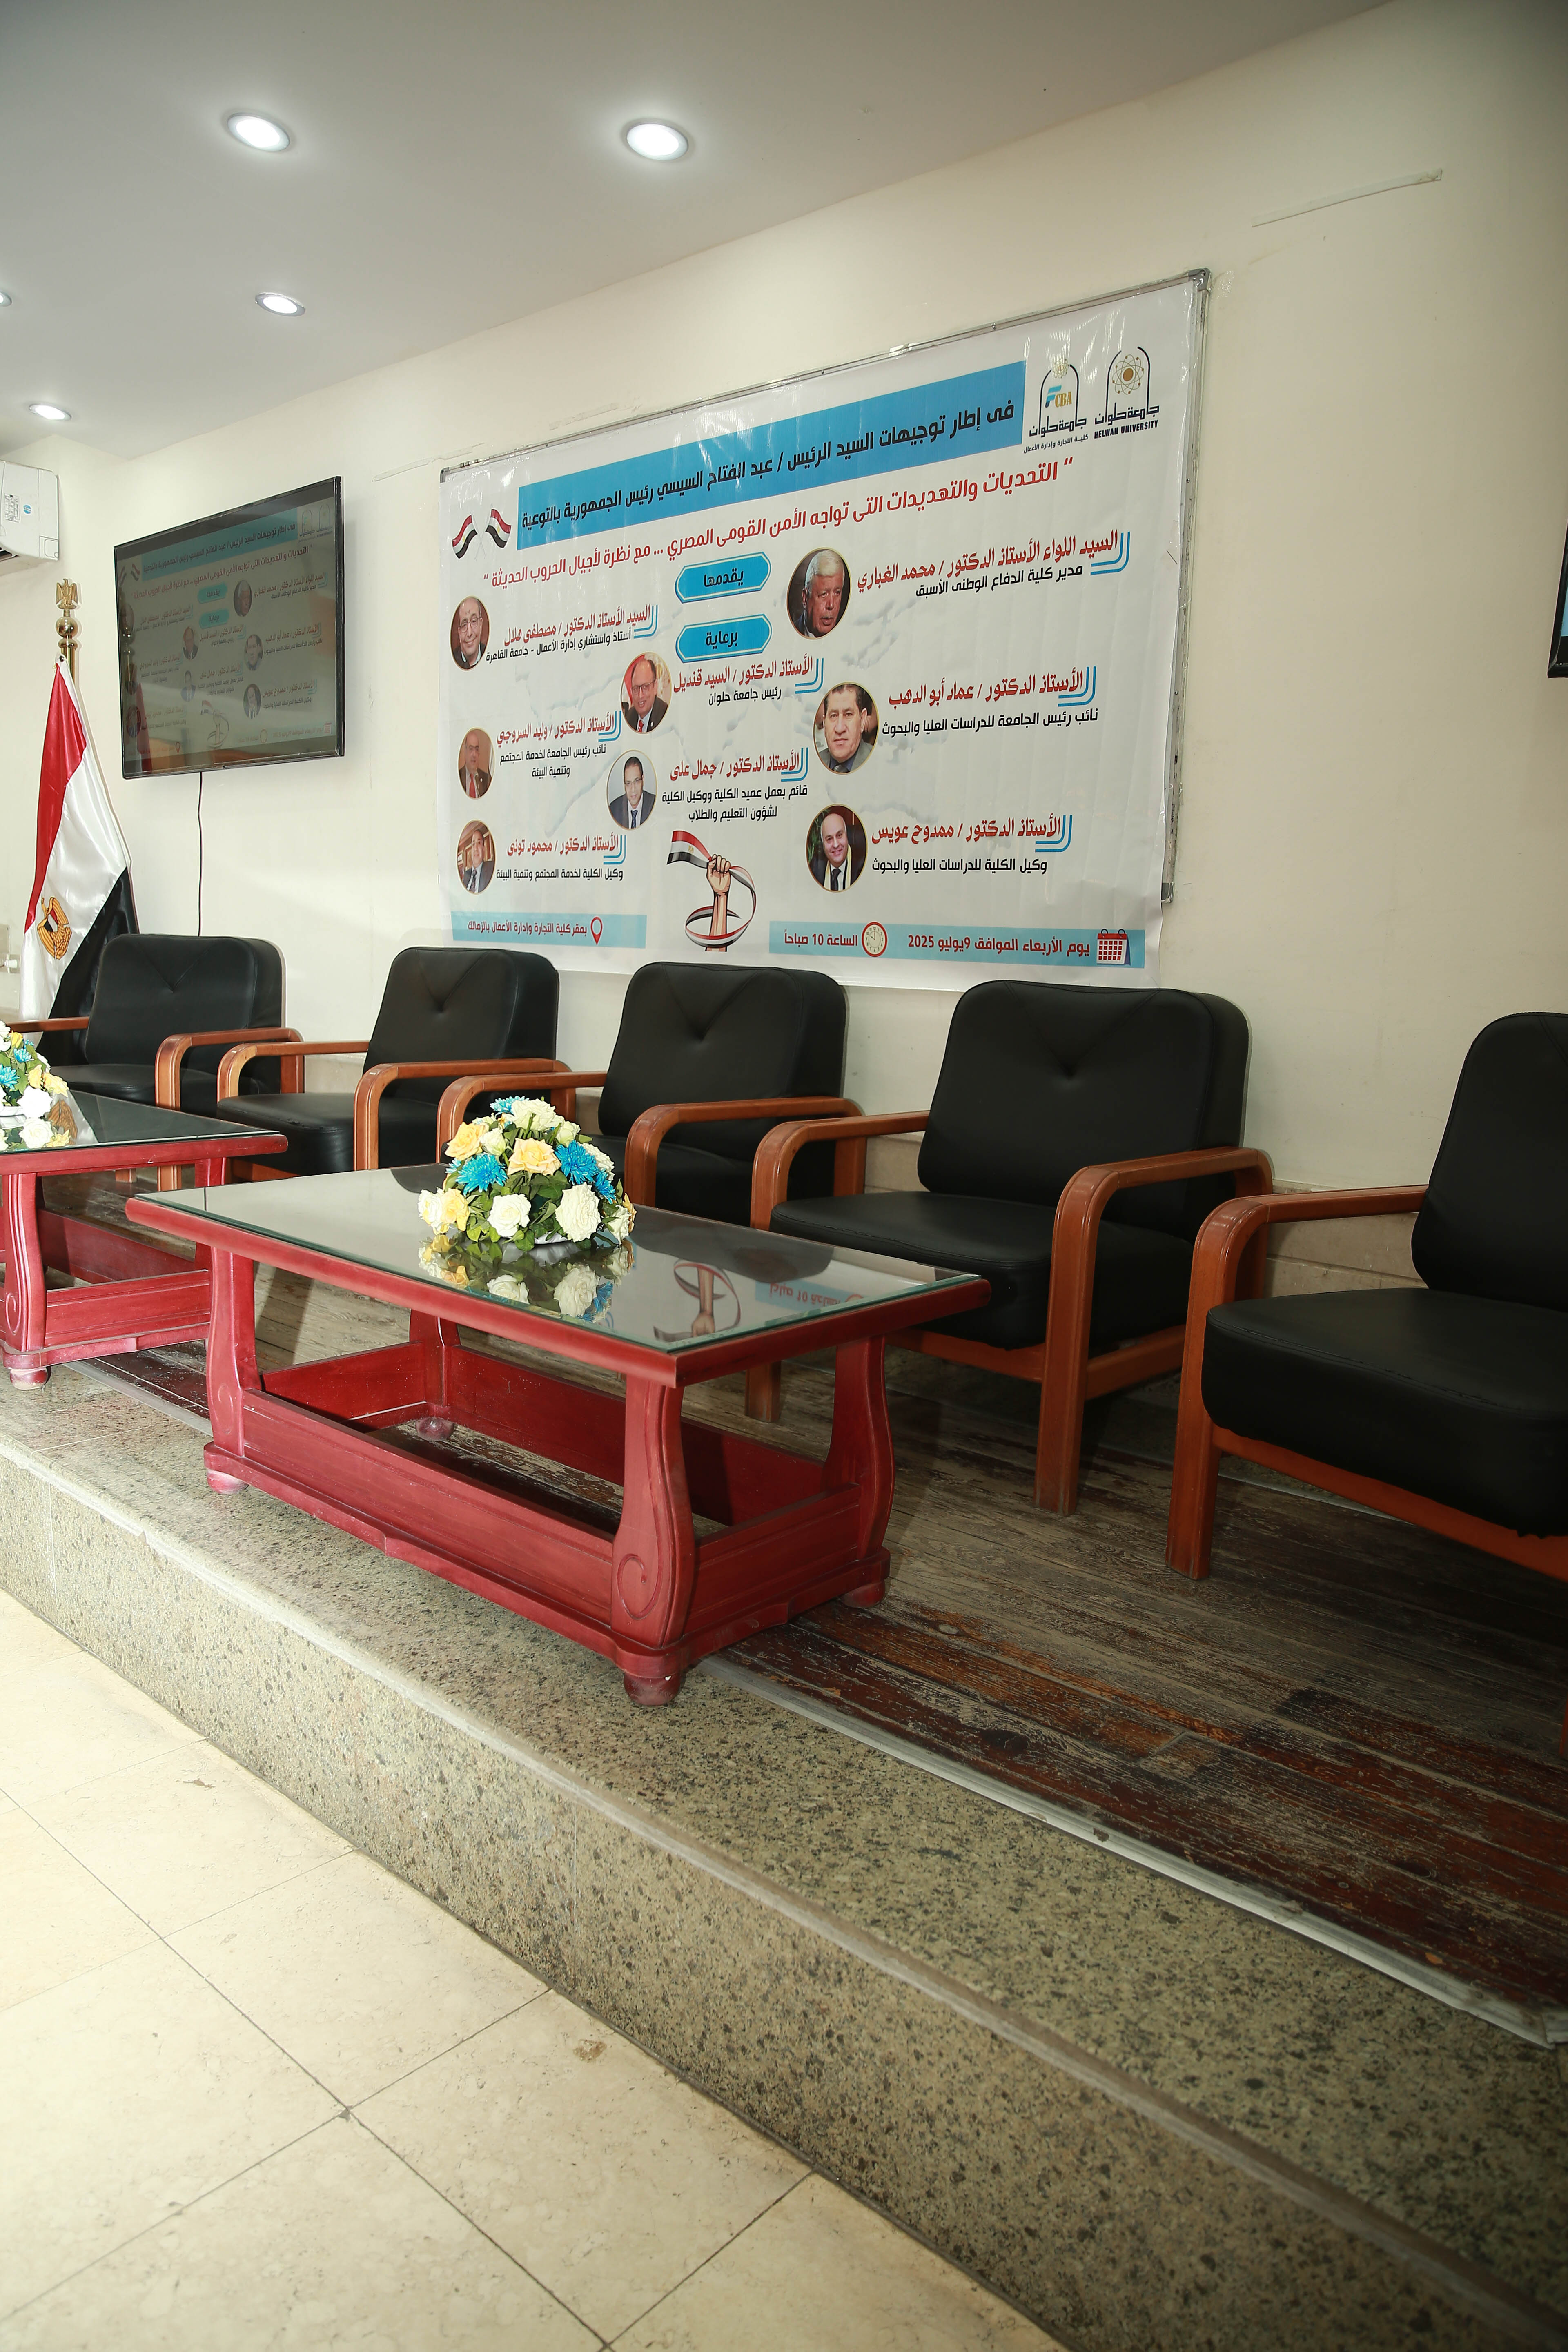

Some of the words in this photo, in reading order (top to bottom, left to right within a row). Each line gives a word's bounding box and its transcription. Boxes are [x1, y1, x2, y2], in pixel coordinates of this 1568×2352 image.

[987, 400, 1014, 423] فى
[1094, 403, 1126, 426] حلوان
[1127, 405, 1159, 419] جامعة
[879, 415, 946, 445] توجيهات
[949, 407, 980, 438] إطار
[1029, 416, 1058, 437] حلوان
[1059, 418, 1087, 432] جامعة
[1094, 427, 1118, 439] HELWAN
[1121, 420, 1158, 434] UNIVERSITY
[836, 432, 873, 459] السيد
[1024, 444, 1040, 454] الأعمال
[1041, 442, 1056, 450] وإدارة
[1058, 437, 1072, 446] التجارة
[788, 442, 831, 471] الرئيس
[707, 462, 745, 491] الفتاح
[751, 459, 773, 479] عبد
[657, 471, 702, 501] السيسي
[983, 462, 1058, 495] التحديات
[626, 485, 653, 507] رئيس
[888, 479, 978, 511] والتهديدات
[564, 490, 621, 521] الجمهورية
[853, 496, 882, 522] التى
[522, 506, 560, 528] بالتوعية
[769, 508, 806, 538] الأمن
[810, 501, 849, 528] تواجه
[717, 519, 766, 547] القومى
[667, 529, 713, 561] المصري
[998, 538, 1040, 566] الأستاذ
[1043, 535, 1076, 563] اللواء
[1079, 529, 1118, 559] السيد
[569, 548, 600, 575] لأجيال
[604, 545, 630, 568] نظرة
[634, 546, 650, 563] مع
[947, 548, 994, 578] الدكتور
[492, 567, 528, 589] الحديثة
[530, 559, 566, 583] الحروب
[704, 568, 743, 587] يقدمها
[858, 563, 898, 593] الغباري
[901, 564, 935, 580] محمد
[1028, 567, 1053, 584] كلية
[1056, 566, 1082, 582] مدير
[916, 579, 948, 599] الأسبق
[952, 576, 987, 592] الوطنى
[991, 570, 1024, 591] الدفاع
[597, 606, 624, 628] الأستاذ
[627, 604, 650, 626] السيد
[524, 623, 556, 643] مصطفى
[564, 613, 595, 637] الدكتور
[504, 626, 522, 646] هلال
[578, 634, 610, 650] واستشاري
[613, 627, 631, 641] أستاذ
[706, 631, 737, 649] برعاية
[510, 646, 528, 657] جامعة
[537, 639, 558, 655] الأعمال
[561, 638, 575, 652] إدارة
[486, 649, 508, 664] القاهرة
[779, 653, 813, 677] الأستاذ
[674, 668, 702, 693] قنديل
[705, 666, 730, 688] السيد
[739, 660, 776, 686] الدكتور
[1039, 667, 1082, 693] الأستاذ
[734, 688, 758, 702] جامعة
[762, 686, 781, 701] رئيس
[929, 677, 945, 706] أبو
[947, 681, 974, 700] عماد
[985, 674, 1035, 702] الدكتور
[708, 691, 730, 706] حلوان
[889, 684, 926, 710] الدهب
[587, 712, 614, 732] الأستاذ
[951, 715, 994, 732] للدراسات
[998, 712, 1039, 728] الجامعة
[1043, 711, 1071, 727] رئيس
[1075, 708, 1098, 725] نائب
[497, 723, 531, 748] السروجي
[533, 722, 547, 741] وليد
[555, 717, 585, 739] الدكتور
[882, 721, 919, 738] والبحوث
[923, 719, 947, 735] العليا
[500, 751, 523, 766] المجتمع
[526, 749, 545, 760] لخدمة
[547, 747, 571, 760] الجامعة
[574, 746, 590, 758] رئيس
[592, 744, 606, 757] نائب
[726, 755, 764, 777] الدكتور
[767, 749, 799, 771] الأستاذ
[532, 767, 547, 779] البيئة
[549, 766, 570, 778] وتنمية
[670, 760, 689, 781] على
[692, 759, 716, 780] جمال
[662, 791, 684, 804] الكلية
[687, 791, 712, 804] ووكيل
[715, 788, 738, 802] الكلية
[742, 789, 761, 801] عميد
[765, 786, 785, 800] بعمل
[788, 785, 807, 800] قائم
[689, 809, 717, 822] والطلاب
[720, 808, 747, 822] التعليم
[751, 805, 777, 821] لشؤون
[911, 823, 954, 844] ممدوح
[966, 817, 1014, 842] الدكتور
[1017, 813, 1060, 837] الأستاذ
[592, 832, 618, 851] الأستاذ
[872, 824, 909, 844] عويس
[508, 839, 525, 856] تونى
[528, 841, 552, 855] محمود
[560, 835, 589, 855] الدكتور
[496, 869, 511, 880] البيئة
[561, 869, 580, 878] لخدمة
[583, 869, 602, 880] الكلية
[605, 868, 623, 881] وكيل
[872, 858, 909, 874] والبحوث
[912, 859, 935, 874] العليا
[939, 859, 980, 874] للدراسات
[985, 859, 1015, 874] الكلية
[1020, 859, 1047, 874] وكيل
[514, 869, 532, 881] وتنمية
[535, 869, 559, 881] المجتمع
[468, 921, 490, 933] بالزمالك
[492, 920, 511, 933] الأعمال
[514, 922, 531, 935] وإدارة
[535, 923, 553, 935] التجارة
[556, 924, 571, 935] كلية
[572, 924, 587, 936] بمقر
[812, 933, 824, 945] 10
[827, 934, 858, 946] الساعة
[908, 935, 934, 949] 2025
[975, 936, 1018, 954] الموافق
[1023, 936, 1062, 956] الأربعاء
[1067, 943, 1090, 957] يوم
